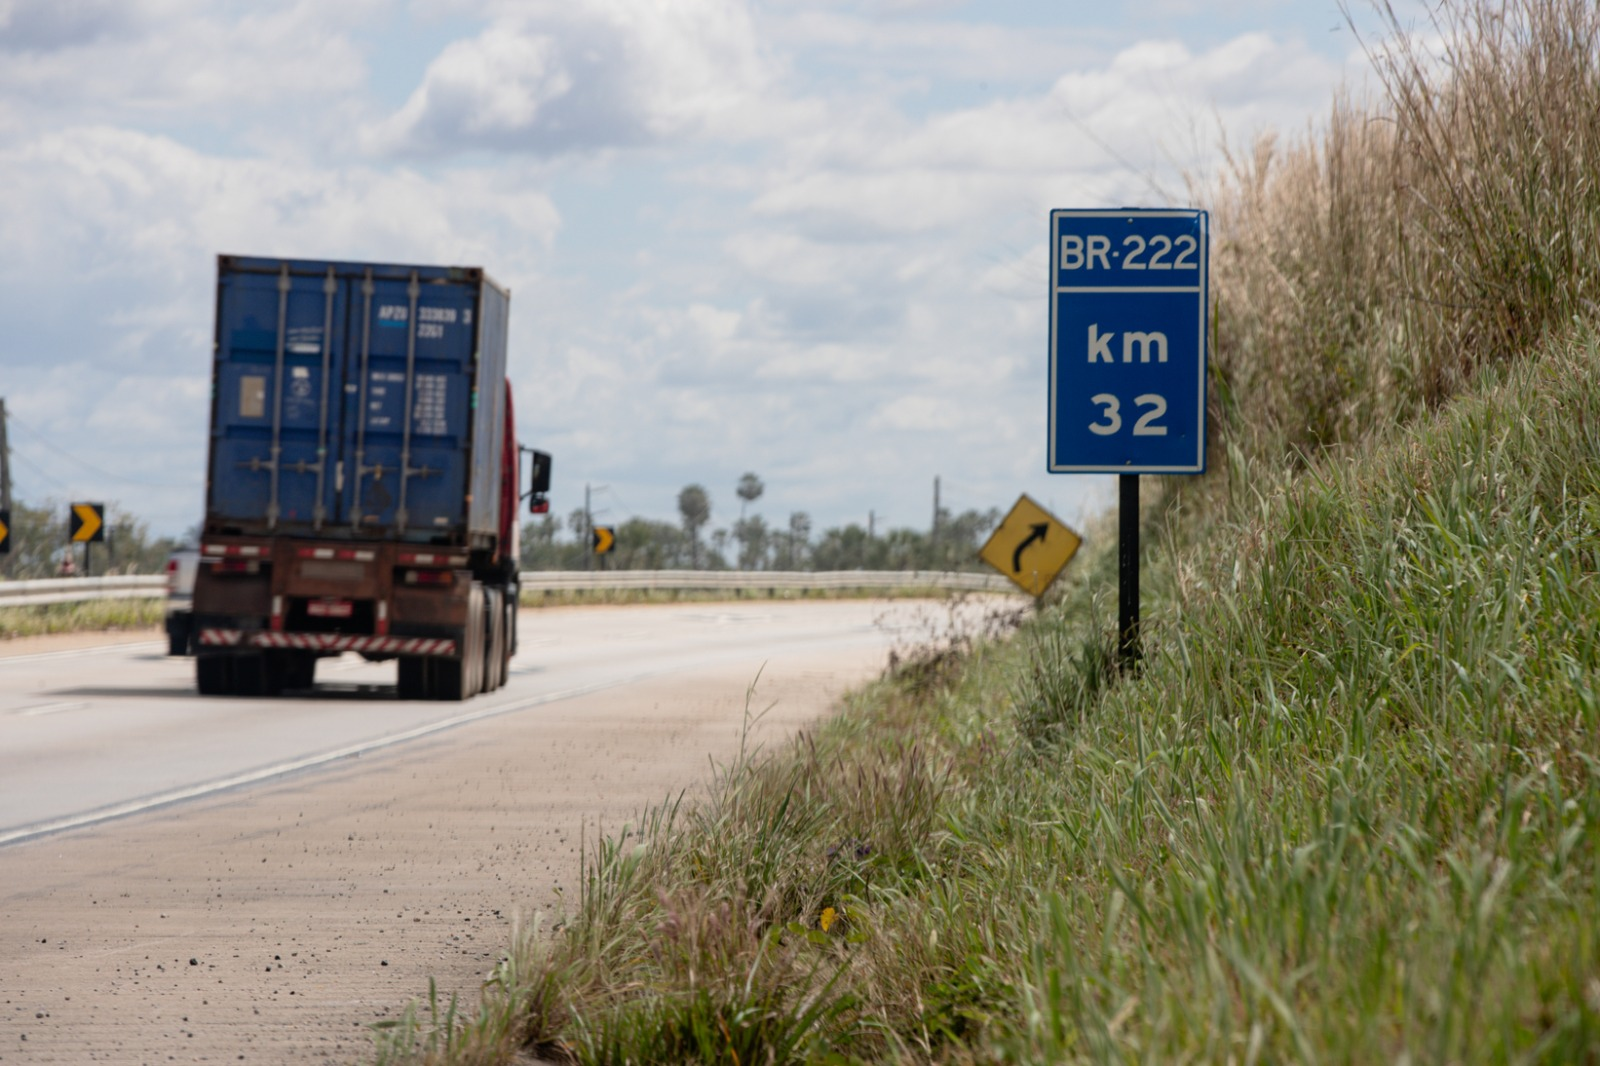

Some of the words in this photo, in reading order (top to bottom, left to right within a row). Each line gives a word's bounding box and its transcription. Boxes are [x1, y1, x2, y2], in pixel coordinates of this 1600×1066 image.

[1060, 235, 1198, 270] BR-222
[1087, 323, 1168, 363] km
[1087, 393, 1168, 436] 32
